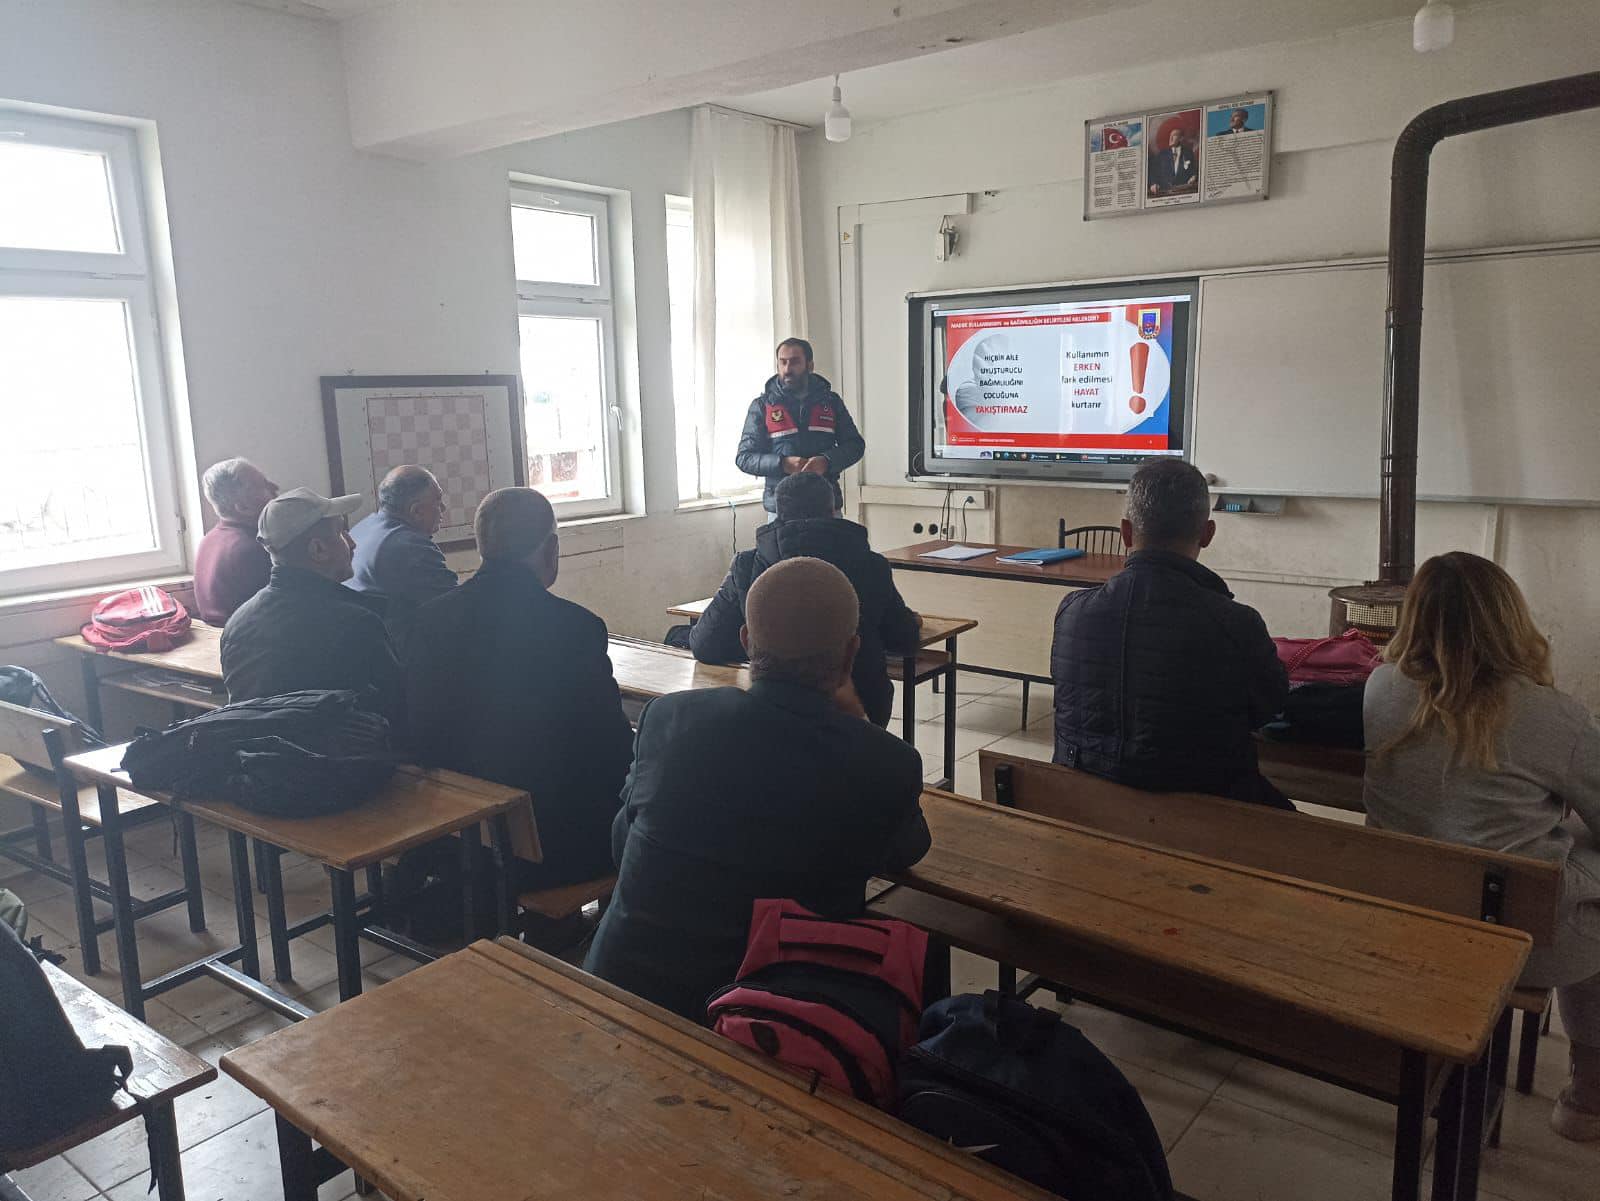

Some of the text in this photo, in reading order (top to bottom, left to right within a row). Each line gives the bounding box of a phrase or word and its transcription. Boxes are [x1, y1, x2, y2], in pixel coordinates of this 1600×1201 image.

[984, 353, 1019, 362] HİÇBİR AİLE
[1066, 350, 1109, 359] Kullanımın
[980, 367, 1023, 375] UYUŞTURUCU
[1074, 363, 1101, 371] ERKEN
[980, 378, 1024, 387] BAĞIMLILIĞINI
[1062, 375, 1113, 384] fark edilmesi
[983, 391, 1019, 400] ÇOCUĞUNA
[1074, 388, 1099, 396] HAYAT
[1071, 400, 1102, 409] kurtarır
[975, 405, 1028, 415] YAKIŞTIRMAZ
